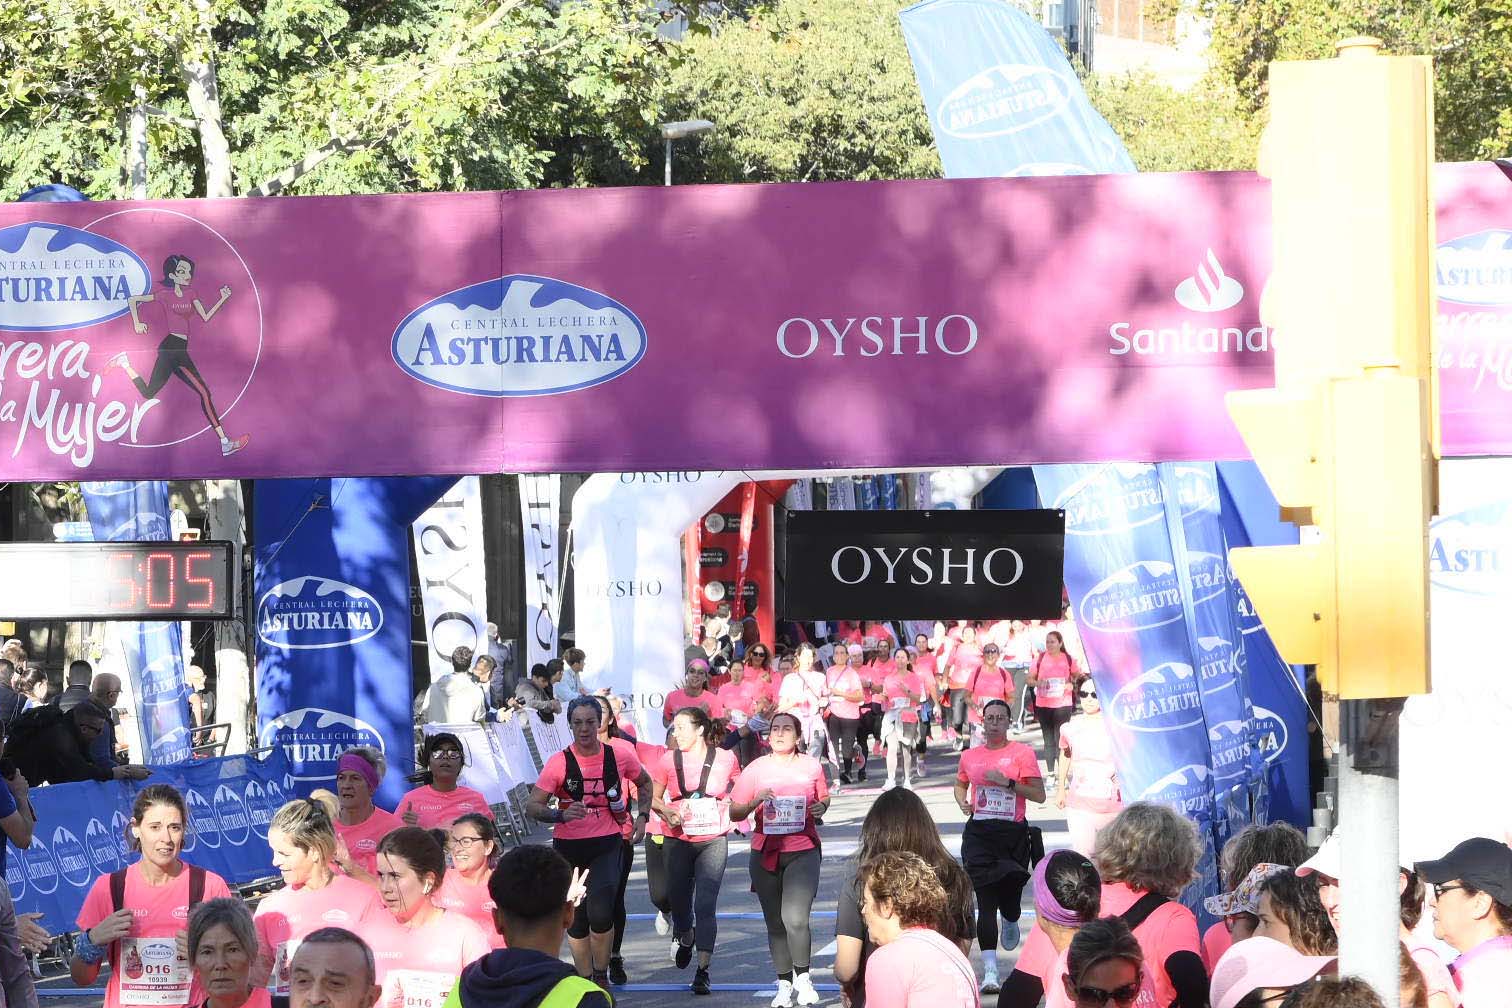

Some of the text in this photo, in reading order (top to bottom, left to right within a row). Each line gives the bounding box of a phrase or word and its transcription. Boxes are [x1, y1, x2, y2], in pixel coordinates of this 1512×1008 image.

[53, 258, 126, 270] LECHERA
[451, 315, 619, 331] CENTRAL LECHERA
[775, 314, 979, 359] OYSHO
[411, 322, 627, 367] ASTURIANA
[11, 375, 161, 468] Mujer
[831, 545, 1025, 586] OYSHO
[274, 601, 316, 609] CENTRAL
[261, 606, 374, 634] ASTURIANA
[145, 964, 171, 974] 016
